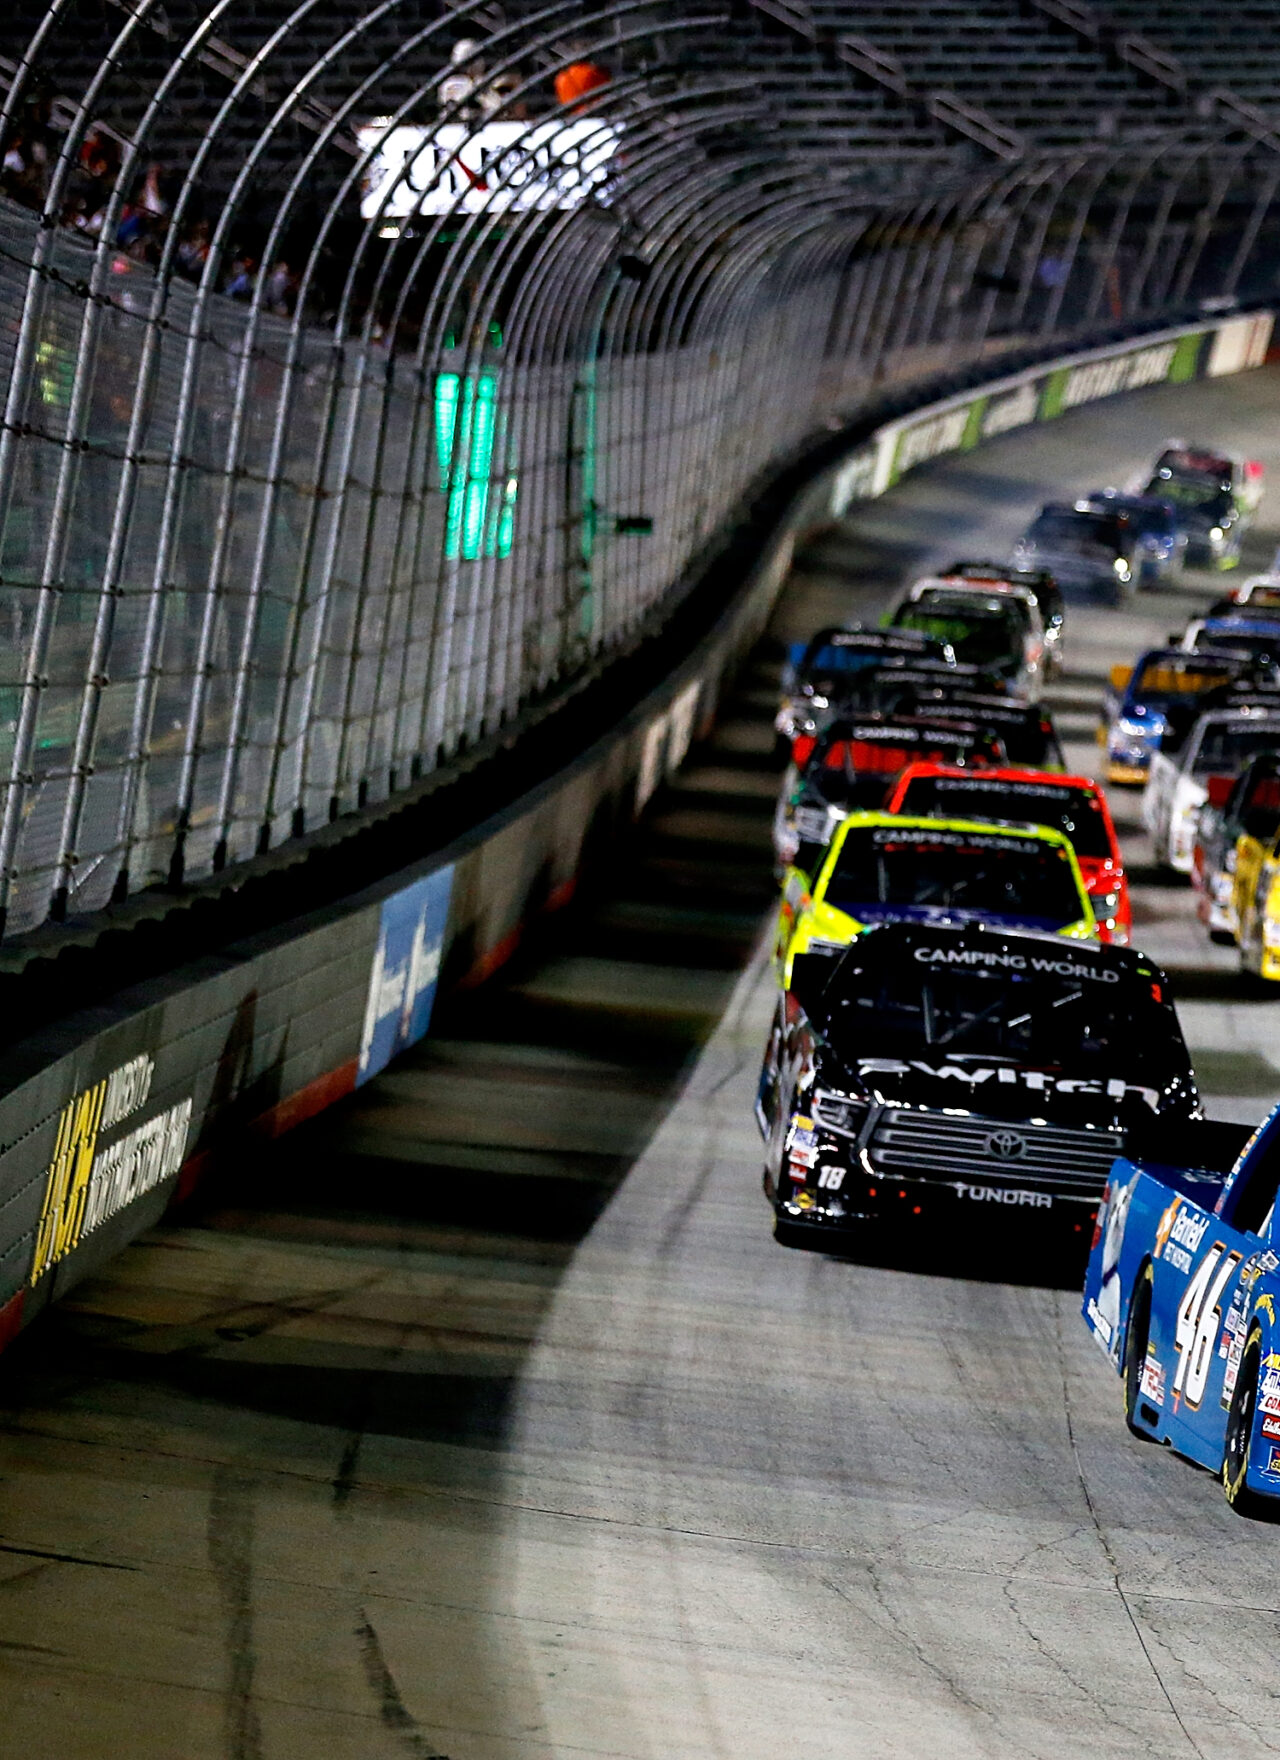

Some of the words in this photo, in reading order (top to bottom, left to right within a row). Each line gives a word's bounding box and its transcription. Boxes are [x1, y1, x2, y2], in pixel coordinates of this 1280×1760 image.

[873, 830, 964, 846] CAMPING
[968, 836, 1039, 854] WORLD
[914, 947, 1026, 969] CAMPING
[1031, 957, 1119, 983] WORLD
[817, 1164, 847, 1191] 18
[954, 1182, 1053, 1208] TUNDRA
[1171, 1240, 1244, 1411] 46
